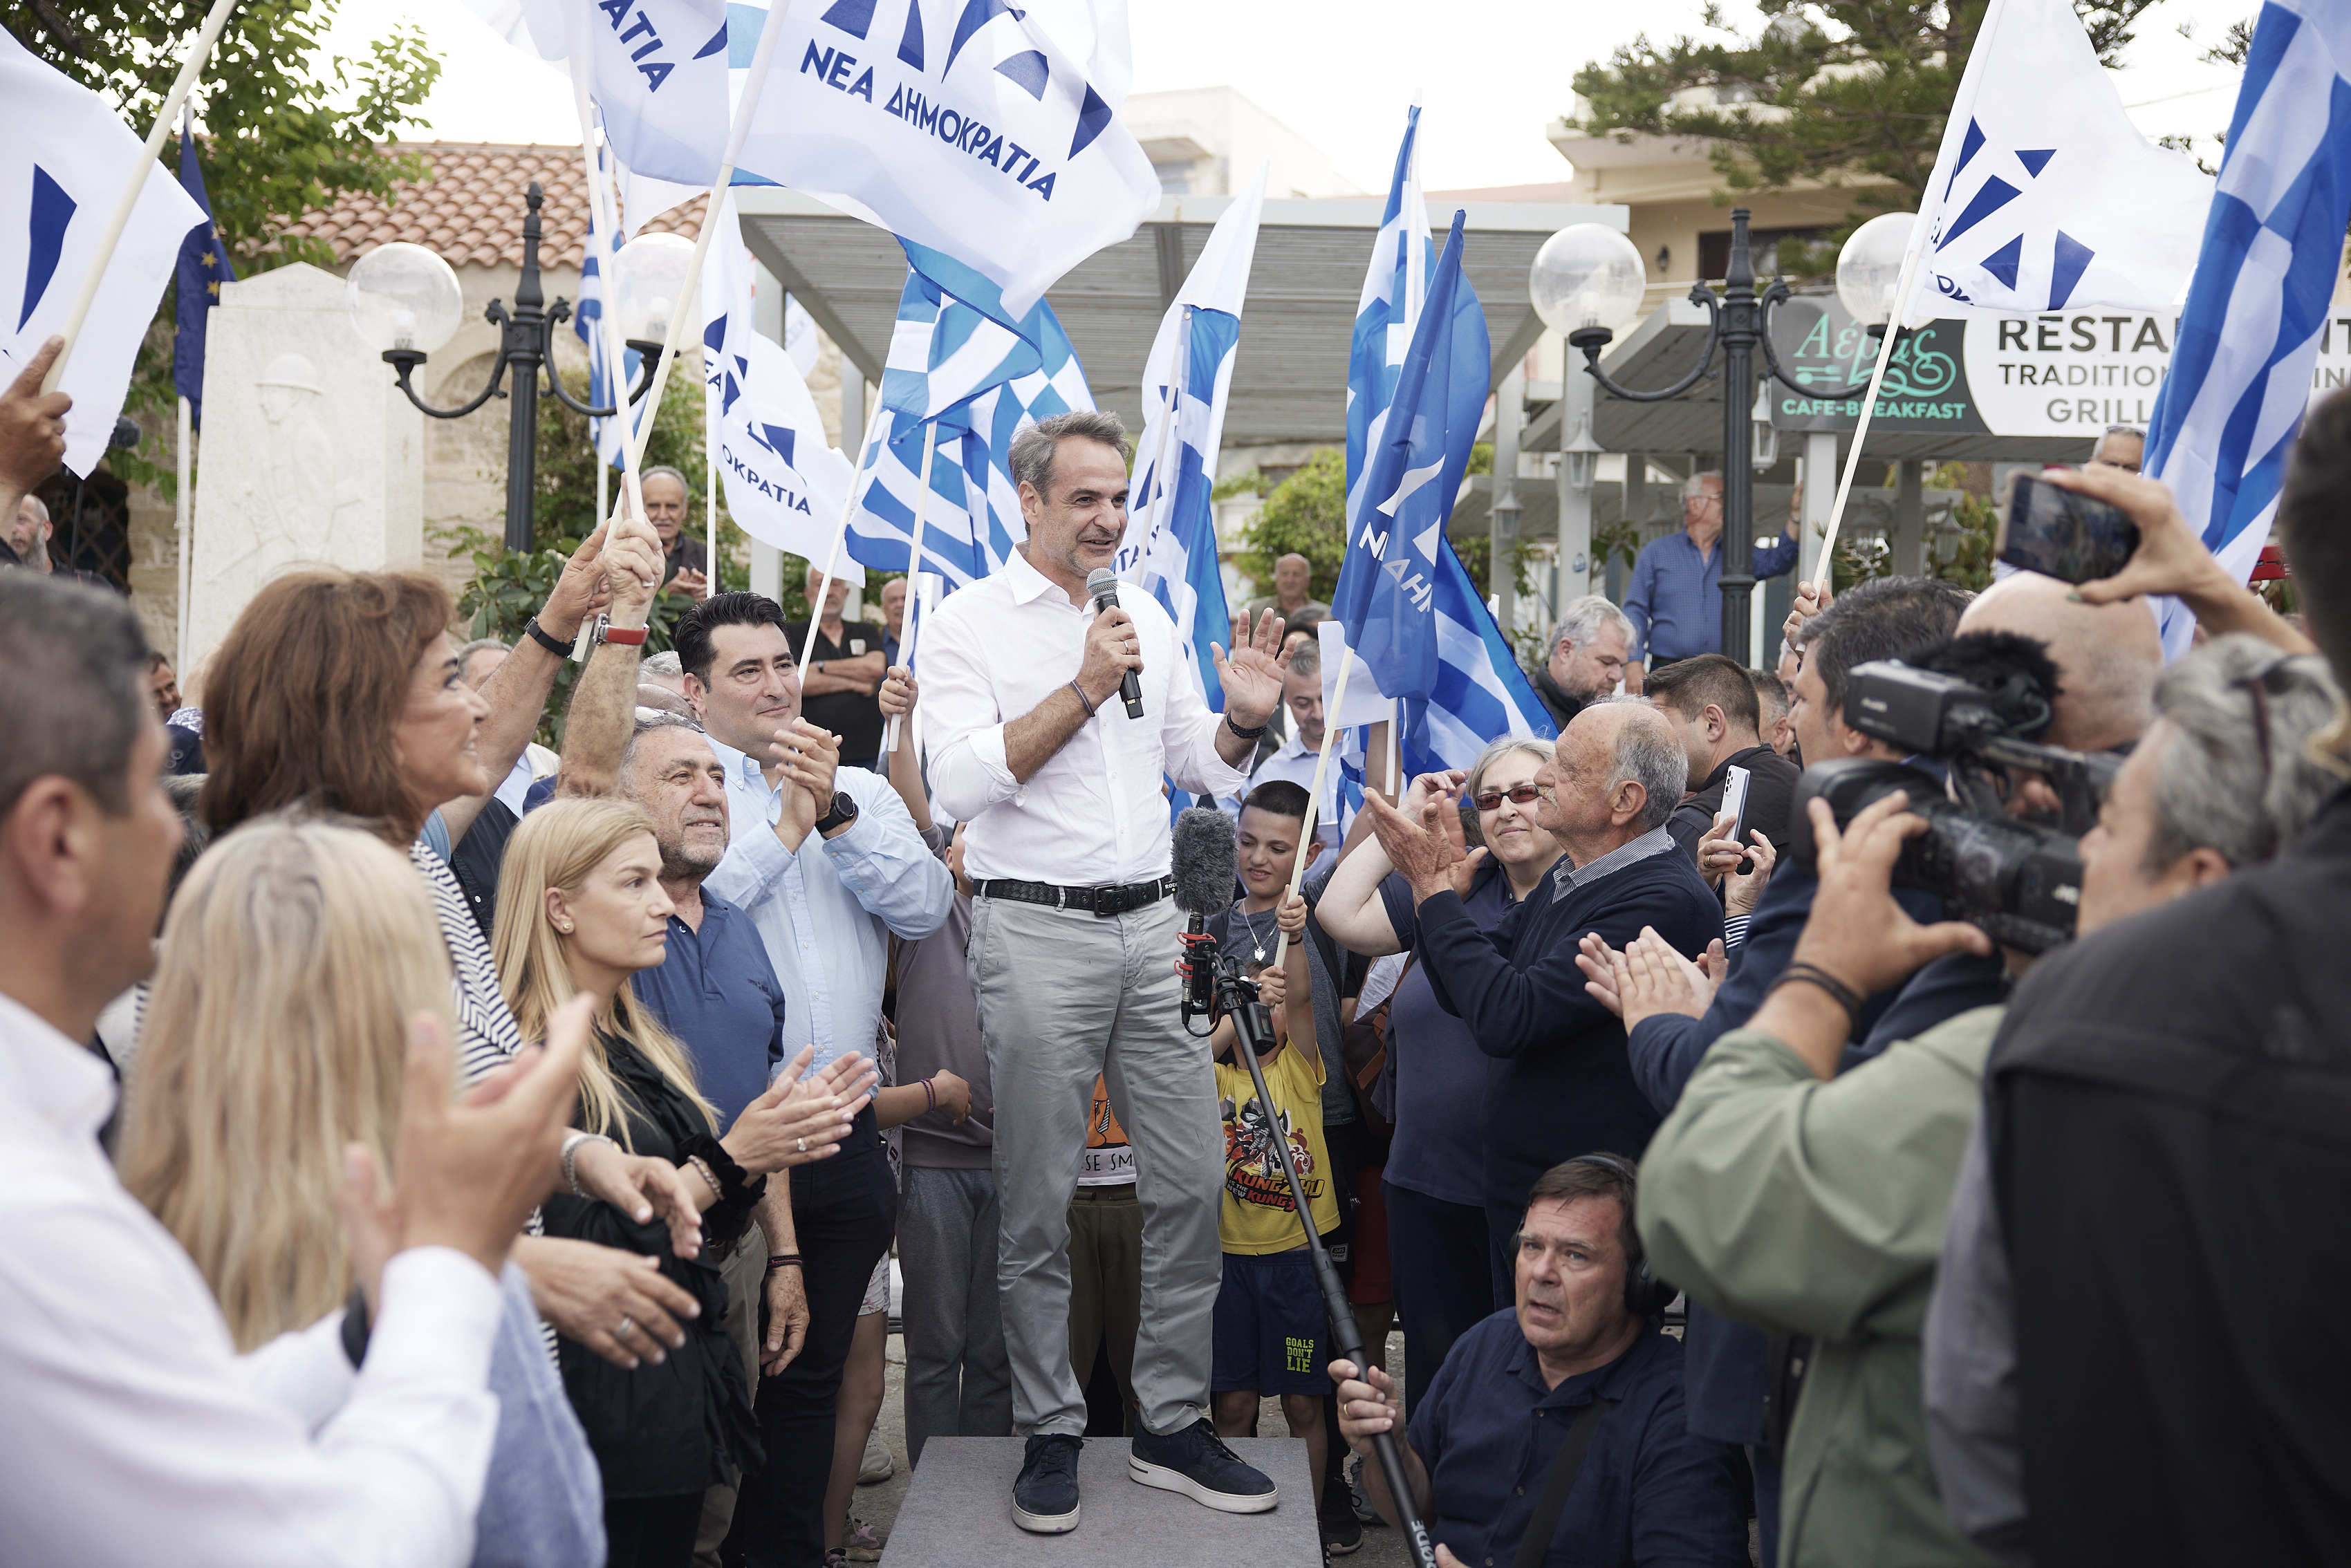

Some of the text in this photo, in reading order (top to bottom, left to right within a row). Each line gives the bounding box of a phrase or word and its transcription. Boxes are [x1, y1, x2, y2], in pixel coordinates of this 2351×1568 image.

[800, 38, 1057, 202] ΝΕΑ ΔΗΜΟΚΡΑΤΙΑ
[1781, 399, 1967, 419] CAFE-BEAKFAST
[1081, 1153, 1132, 1170] SE SM
[1227, 1184, 1247, 1198] NEW
[1236, 1184, 1249, 1193] THE
[1285, 1336, 1314, 1349] GOALS
[1287, 1346, 1313, 1359] DON'T
[1287, 1356, 1310, 1373] LIE
